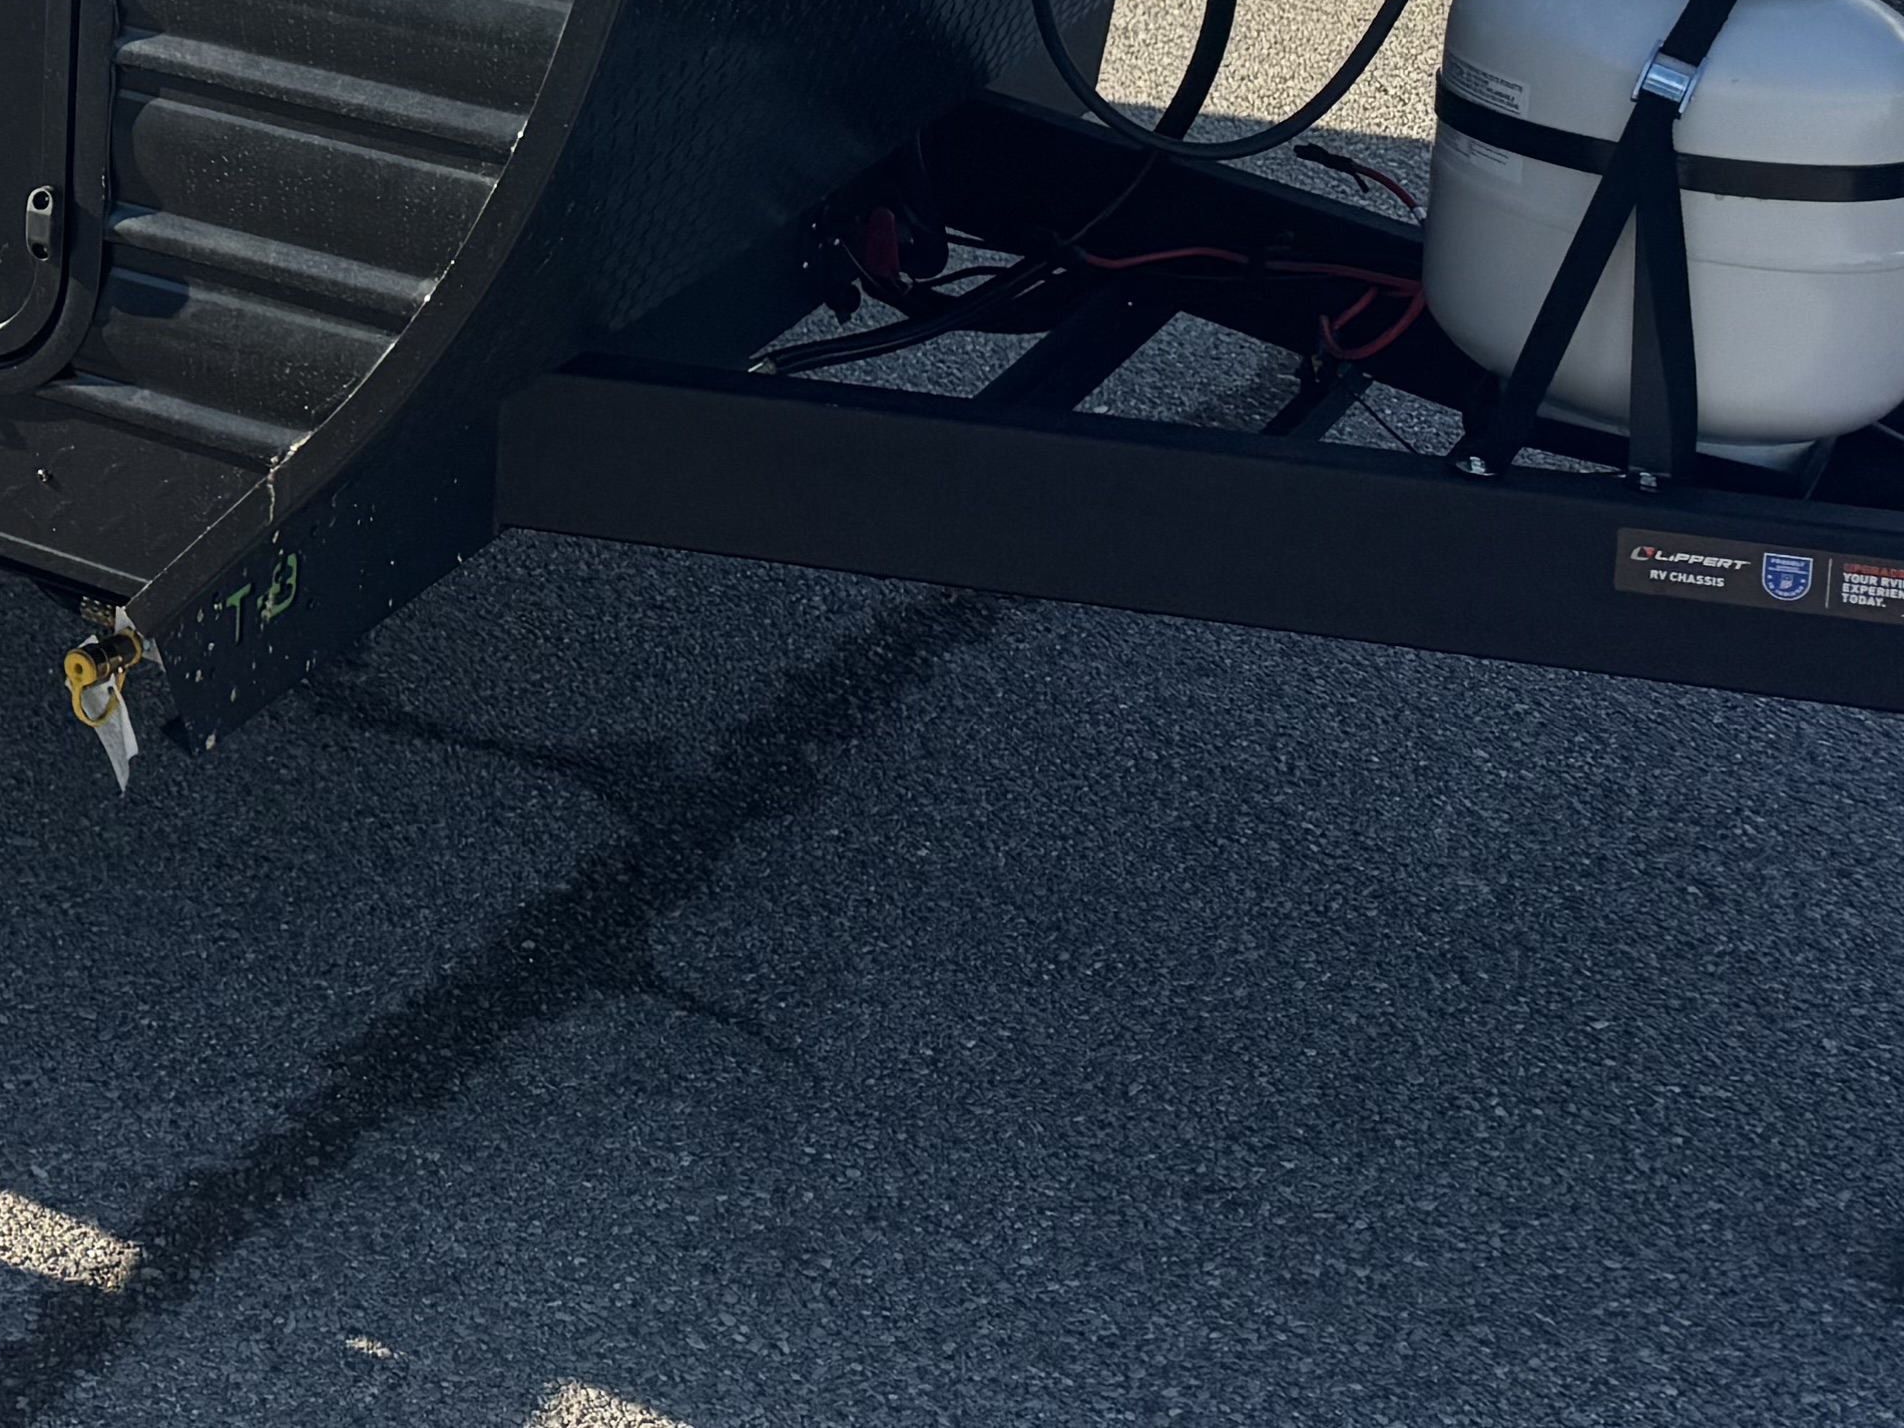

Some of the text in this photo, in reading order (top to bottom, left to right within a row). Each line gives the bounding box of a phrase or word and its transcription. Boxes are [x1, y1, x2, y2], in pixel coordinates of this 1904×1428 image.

[1649, 569, 1726, 589] RV CHASSIS
[1842, 572, 1879, 586] YOUR
[1841, 592, 1887, 608] TODAY.
